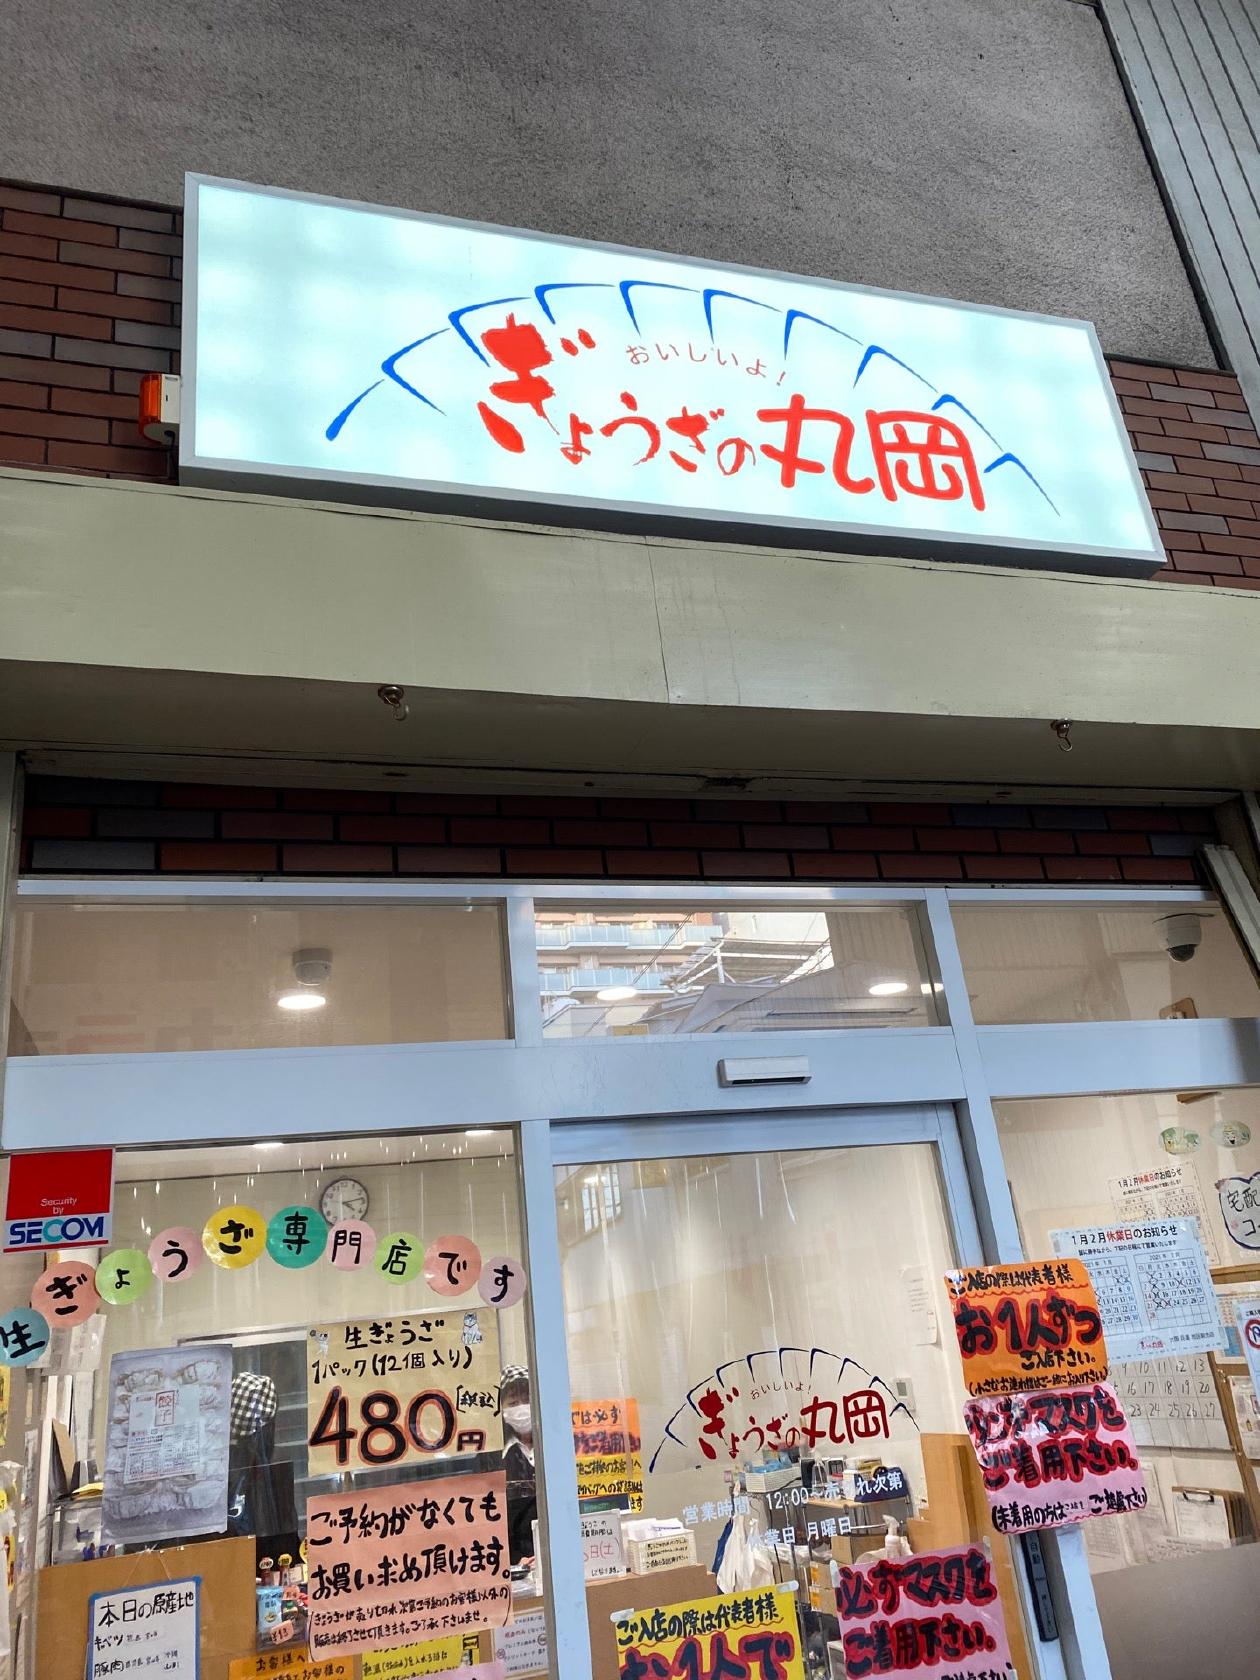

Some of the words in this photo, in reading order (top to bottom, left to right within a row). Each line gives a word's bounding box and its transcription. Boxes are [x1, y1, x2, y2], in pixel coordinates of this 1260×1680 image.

[477, 313, 986, 511] ぎょうざの丸岡
[40, 1196, 77, 1207] Security
[52, 1206, 65, 1215] by
[1227, 1187, 1260, 1212] 宅配
[9, 1216, 104, 1245] SECOM
[1071, 1225, 1178, 1245] 1月2月休業日のお知らせ
[344, 1320, 445, 1350] 生ぎょうざ
[955, 1291, 1101, 1357] お1人ずつ
[312, 1346, 473, 1384] 1パック(12個入り)
[1020, 1348, 1096, 1371] ご入店下さい。
[1140, 1361, 1149, 1374] 10
[1158, 1360, 1166, 1372] 11
[1176, 1361, 1187, 1373] 12
[1194, 1358, 1205, 1372] 13
[1127, 1381, 1136, 1396] 16
[1144, 1381, 1154, 1394] 17
[1164, 1380, 1173, 1395] 18
[1181, 1380, 1190, 1395] 19
[1200, 1382, 1210, 1394] 20
[698, 1386, 890, 1461] ぎょうざの丸岡
[1130, 1403, 1142, 1417] 23
[1149, 1402, 1160, 1416] 24
[1168, 1403, 1180, 1418] 25
[1186, 1402, 1198, 1418] 26
[1205, 1402, 1215, 1418] 27
[981, 1437, 1139, 1492] ご着用下さい。
[310, 1490, 502, 1546] ご予約がなくても
[682, 1495, 751, 1526] 営業時間
[807, 1516, 852, 1542] 月曜日
[310, 1536, 511, 1601] お買い求め頂けます。
[835, 1548, 998, 1620] 必ずマスクを
[98, 1590, 194, 1628] 本日の原産地
[616, 1592, 779, 1646] ご入店の際は代表者様
[843, 1613, 997, 1679] ご着用下さい。
[94, 1659, 125, 1678] 豚肉
